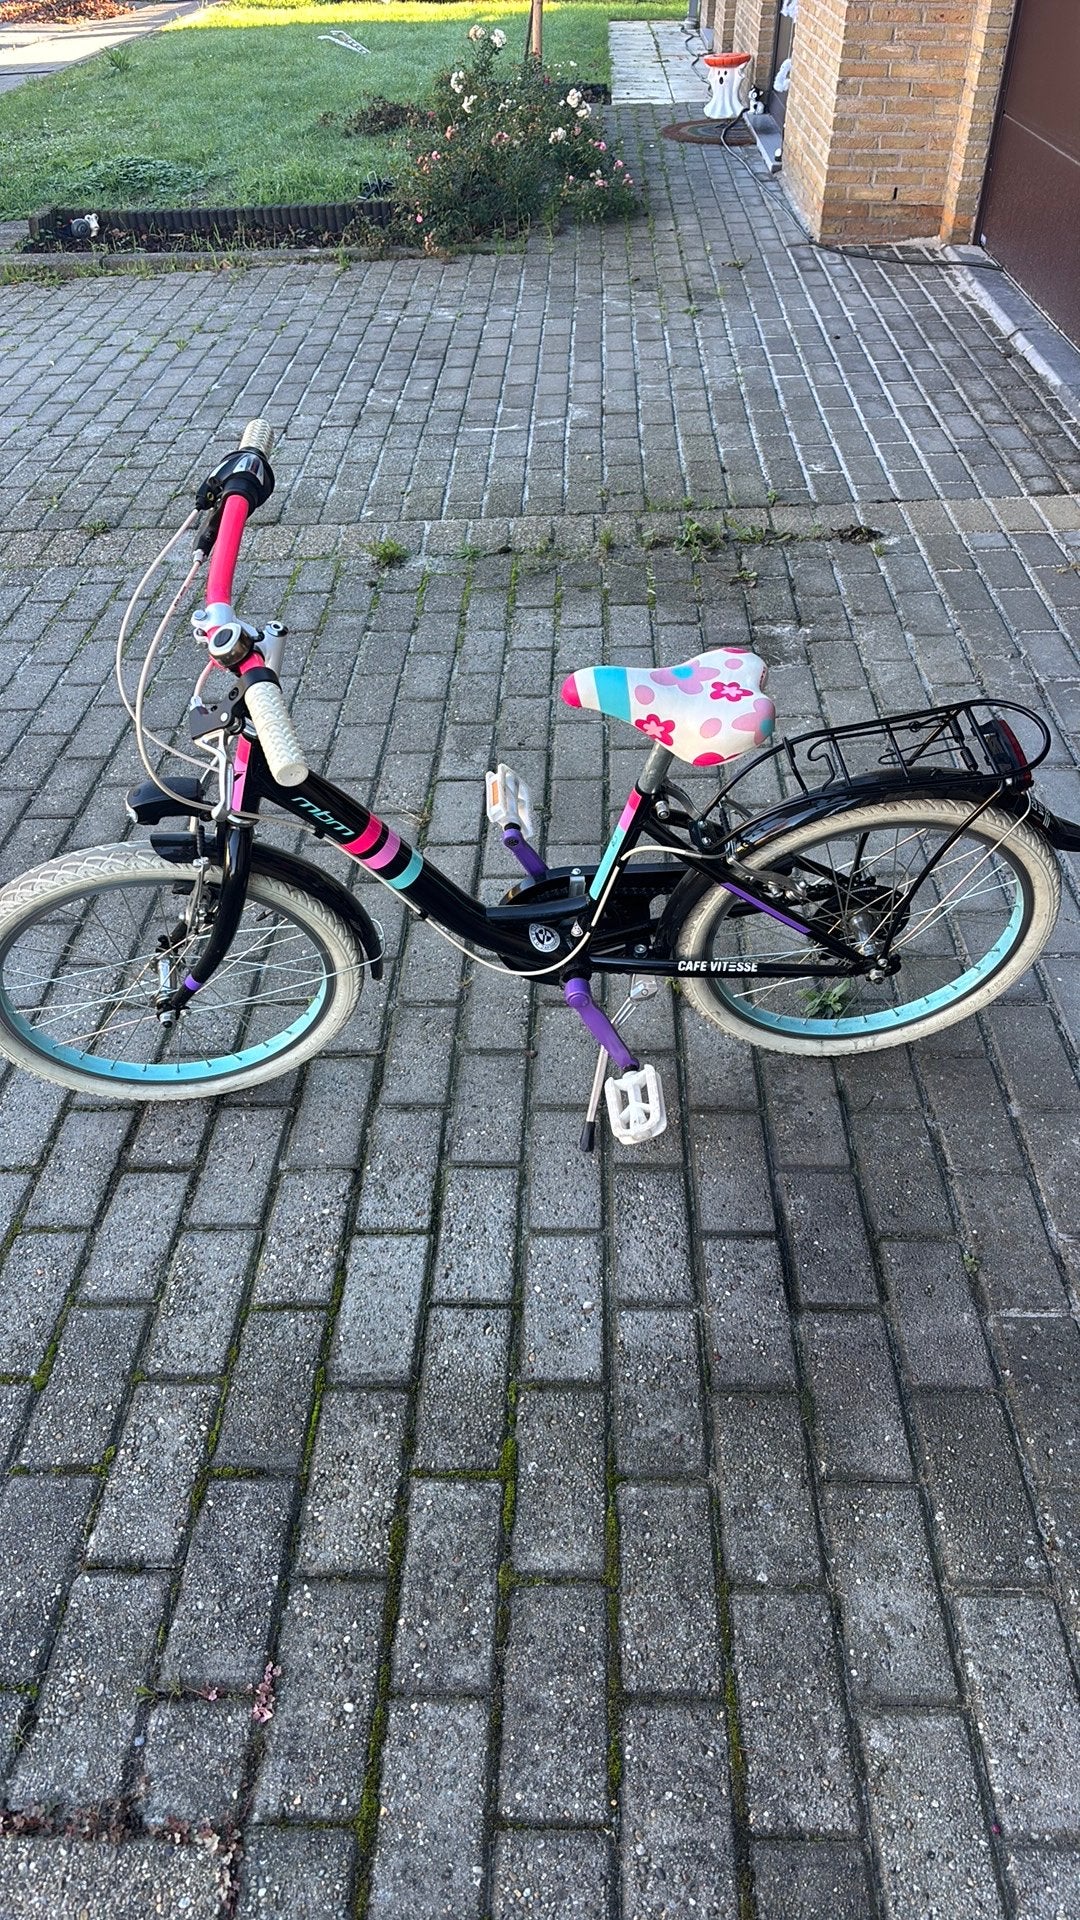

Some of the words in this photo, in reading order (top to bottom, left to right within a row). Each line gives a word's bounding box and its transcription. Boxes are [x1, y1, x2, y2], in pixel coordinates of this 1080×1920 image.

[291, 797, 355, 836] mbm
[678, 960, 708, 972] CAFE
[710, 961, 758, 972] VITESSE
